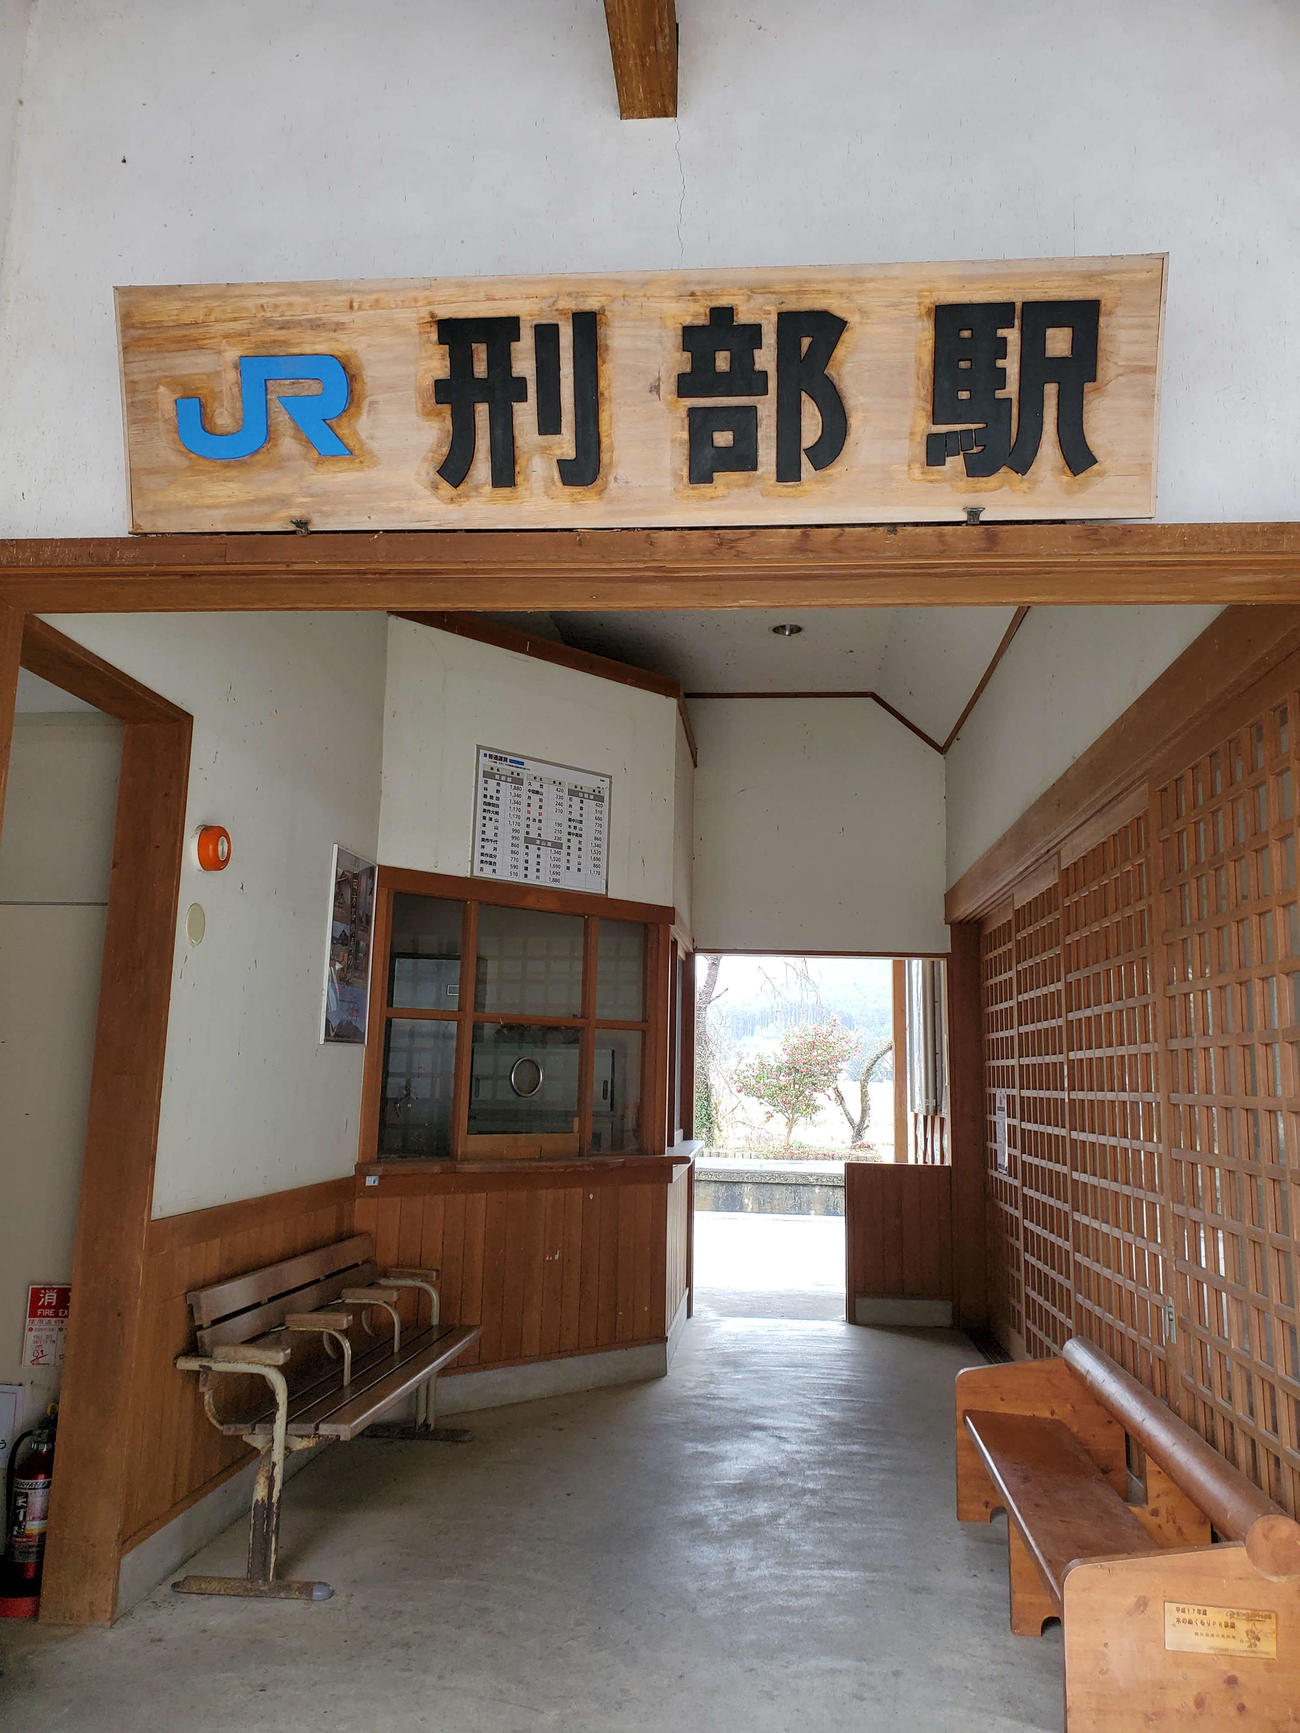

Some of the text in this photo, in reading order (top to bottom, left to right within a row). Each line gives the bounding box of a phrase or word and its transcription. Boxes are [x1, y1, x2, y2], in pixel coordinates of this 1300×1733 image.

[175, 299, 1100, 489] JR 刑部駅
